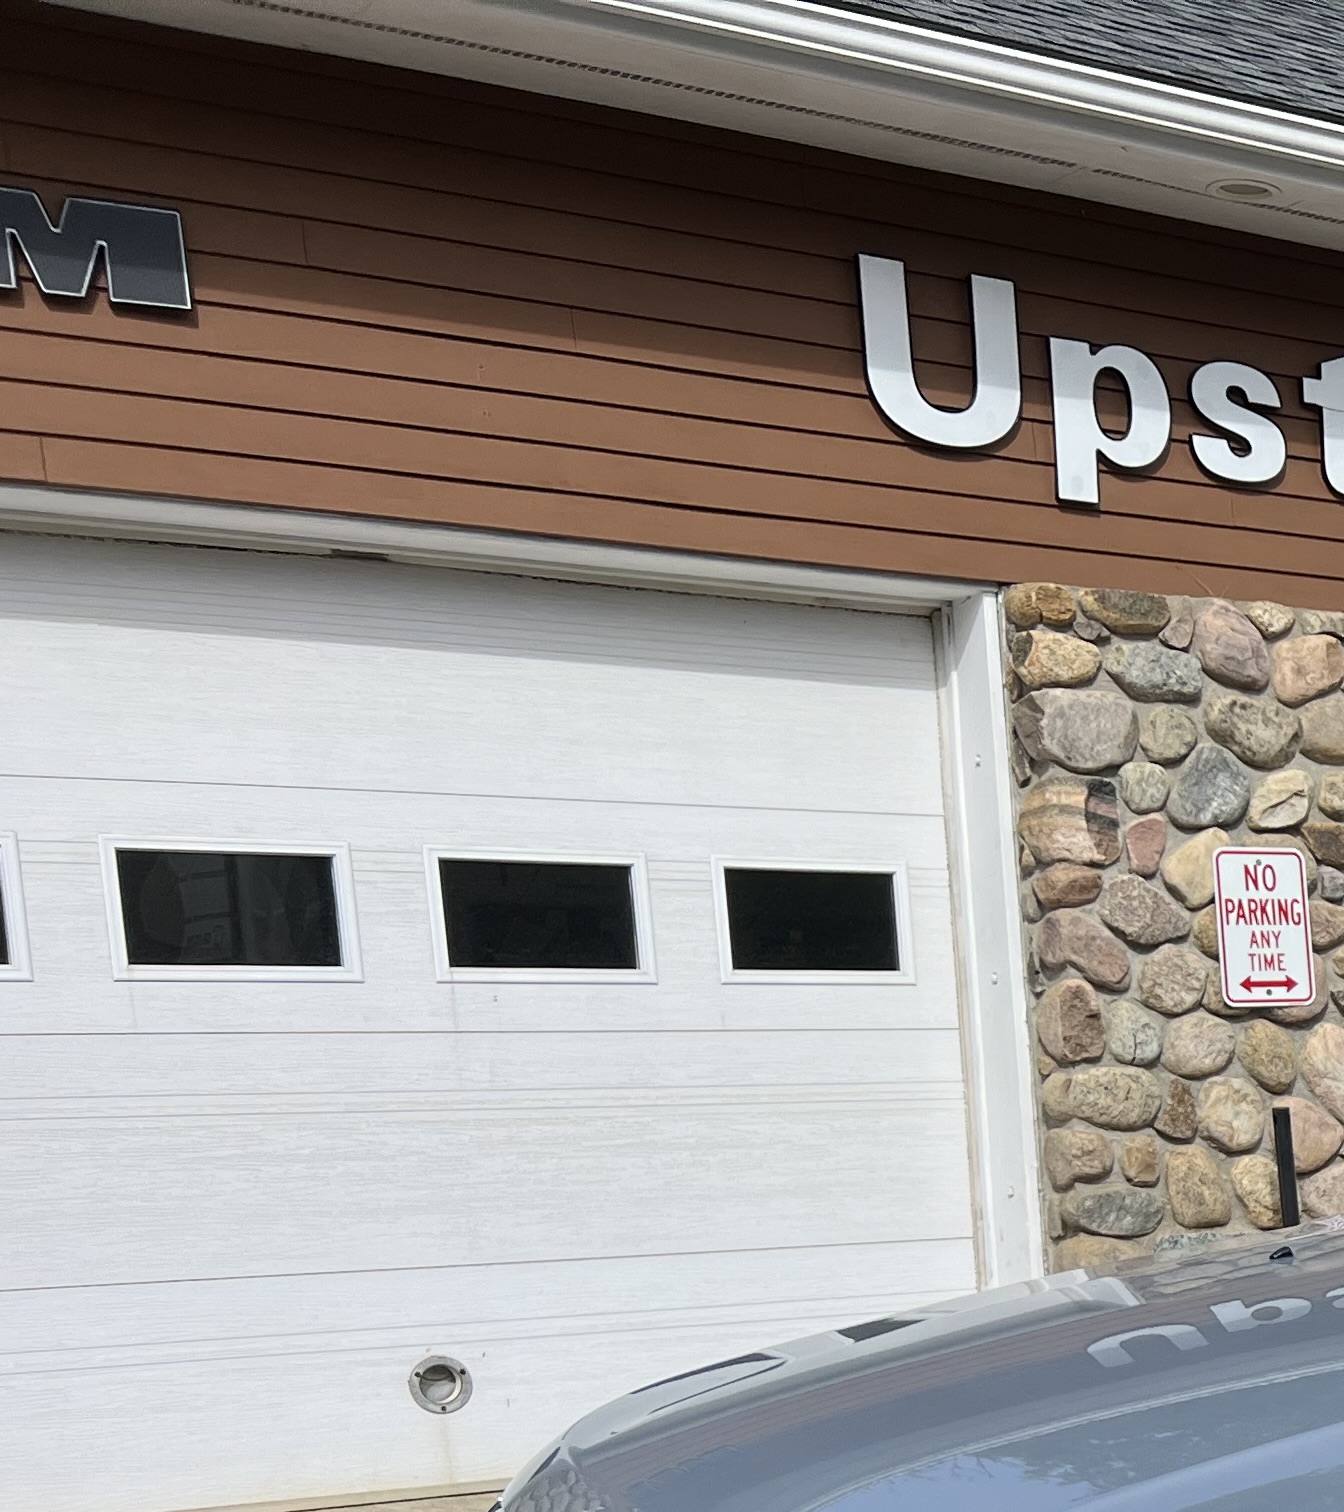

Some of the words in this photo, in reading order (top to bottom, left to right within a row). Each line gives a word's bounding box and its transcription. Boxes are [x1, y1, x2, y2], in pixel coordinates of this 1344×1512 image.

[1244, 864, 1277, 892] NO
[1224, 898, 1302, 926] PARKING
[1249, 930, 1281, 949] ANY
[1248, 953, 1287, 972] TIME
